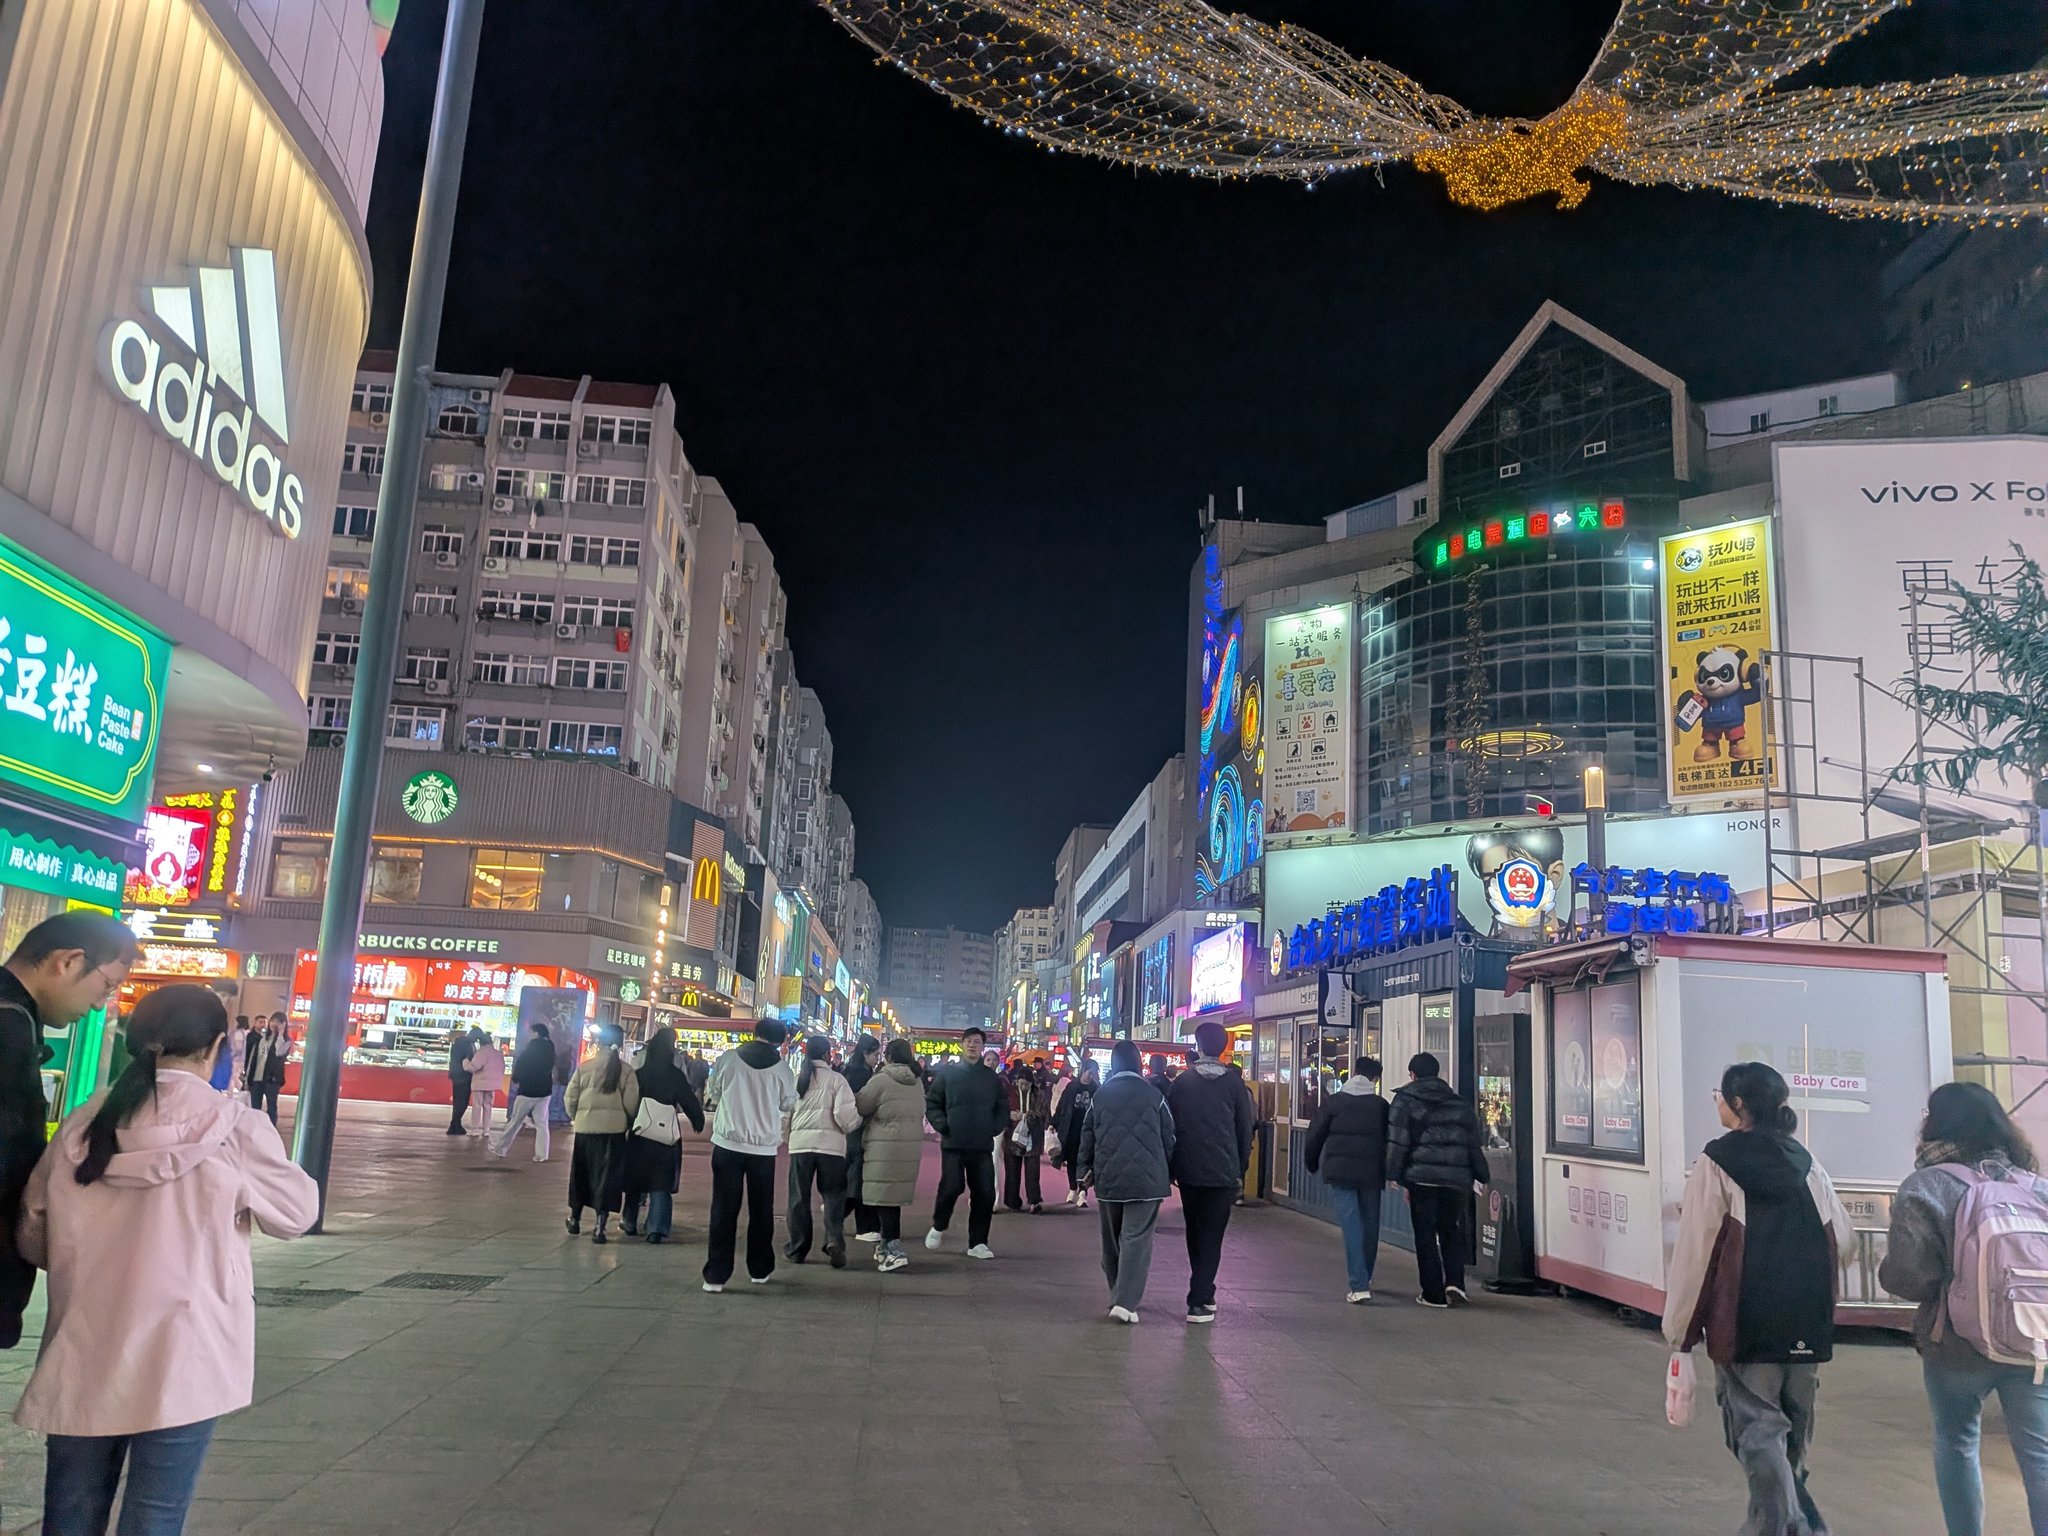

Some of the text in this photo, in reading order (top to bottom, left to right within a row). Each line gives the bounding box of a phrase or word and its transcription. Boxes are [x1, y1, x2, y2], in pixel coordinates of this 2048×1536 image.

[111, 319, 303, 540] adidas
[1861, 481, 2048, 504] vivo X Fo
[1708, 537, 1756, 559] 玩小将
[1676, 570, 1760, 599] 玩出不一样
[1676, 588, 1761, 616] 就来玩小将
[1275, 627, 1341, 647] 一站式服务
[1730, 621, 1748, 634] 24
[0, 615, 98, 744] 豆糕
[1281, 668, 1336, 701] 喜爱宠
[104, 694, 131, 722] Bean
[1308, 700, 1334, 709] Chong
[101, 712, 130, 739] Paste
[97, 731, 124, 756] Cake
[1678, 768, 1729, 783] 电梯直达
[1734, 778, 1753, 788] 5325
[9, 845, 118, 892] 用心制作 真心出品
[1287, 864, 1454, 969] 台东步行街警务站
[430, 938, 499, 953] COFFEE
[606, 948, 647, 968] 星巴克咖啡
[461, 968, 524, 985] 冷萃酸奶
[671, 961, 702, 982] 麦当劳
[1793, 1075, 1859, 1089] Baby Care
[1605, 1116, 1630, 1127] Baby Care
